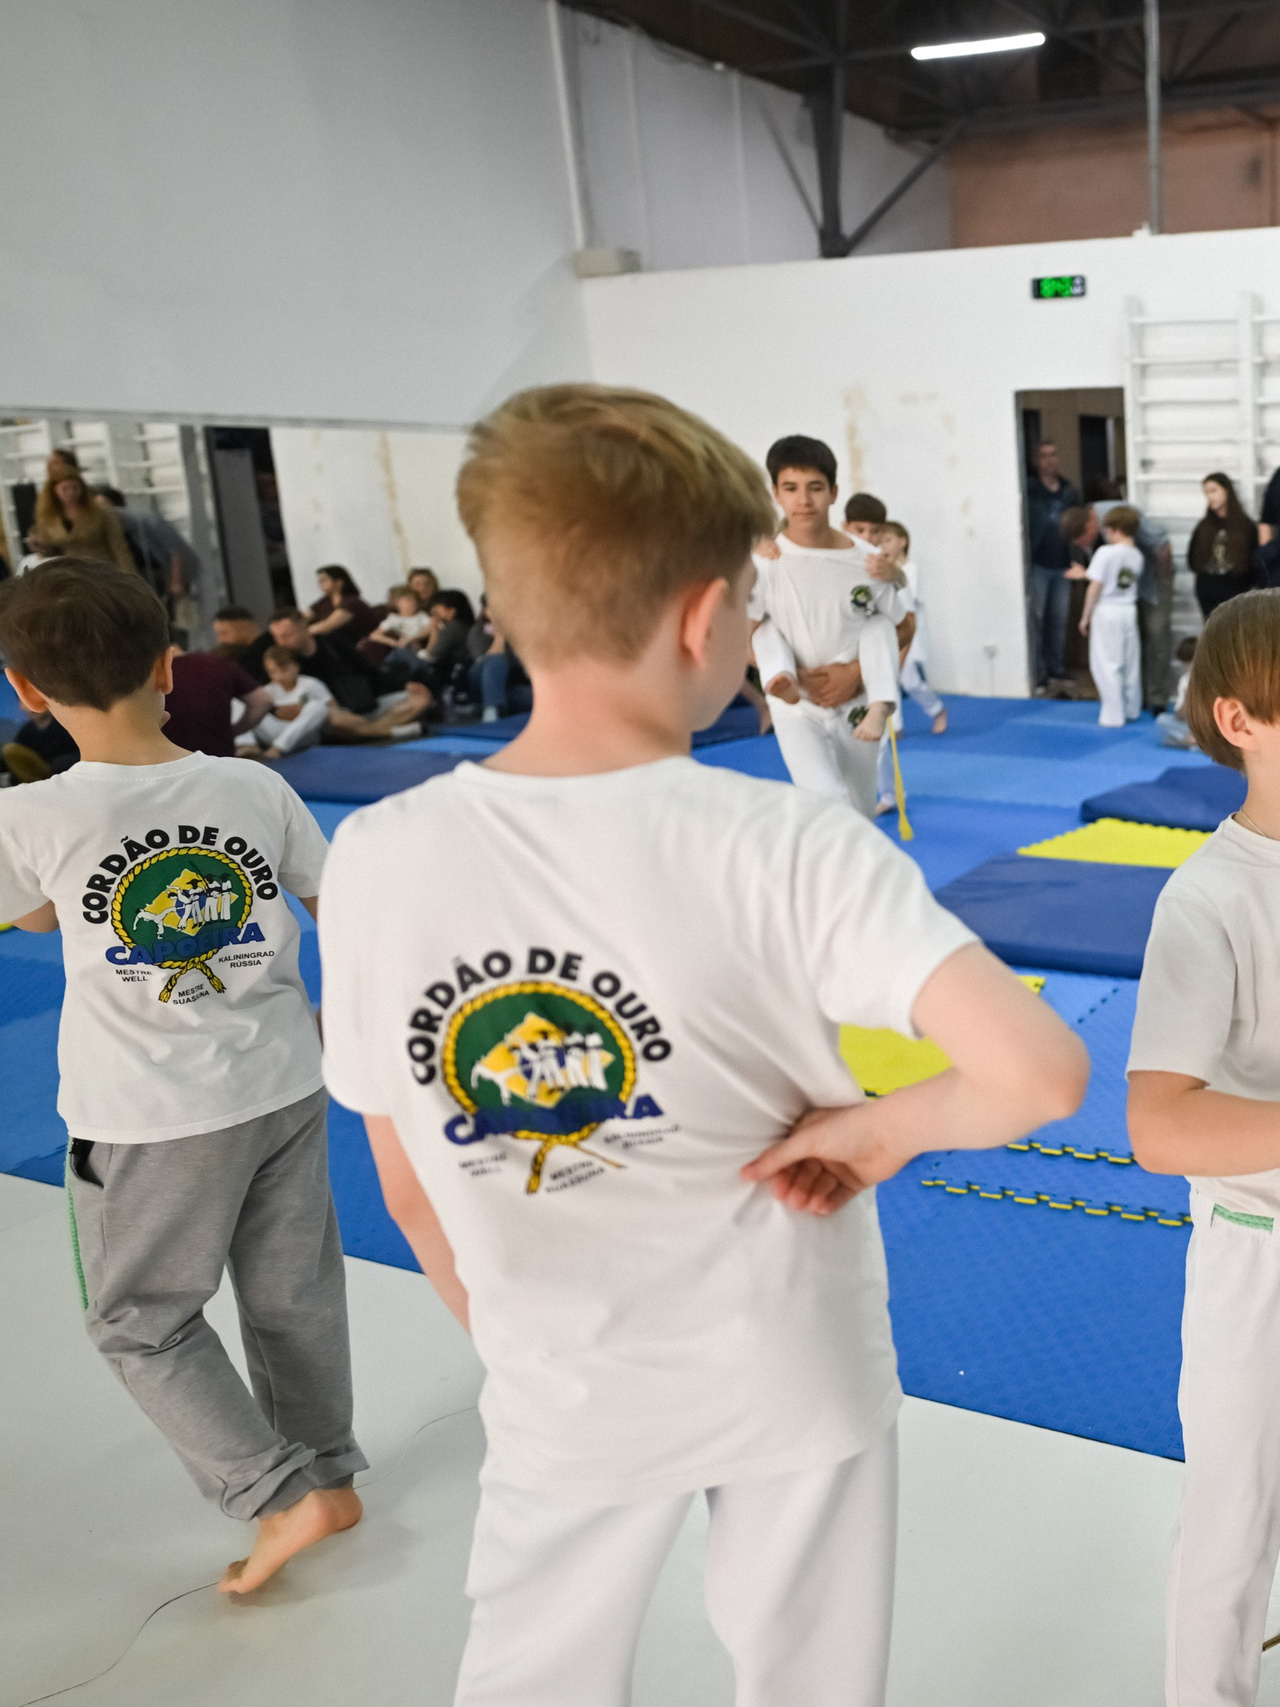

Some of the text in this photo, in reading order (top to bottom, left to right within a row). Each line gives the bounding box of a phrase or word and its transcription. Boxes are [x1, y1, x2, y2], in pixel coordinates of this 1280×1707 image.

[82, 825, 279, 924] CORDÃO DE OURO
[105, 921, 266, 966] CAPOEIRA
[218, 950, 275, 963] KALININGRAD
[178, 983, 205, 998] MESTRE
[407, 947, 672, 1086] CORDÃO DE OURO
